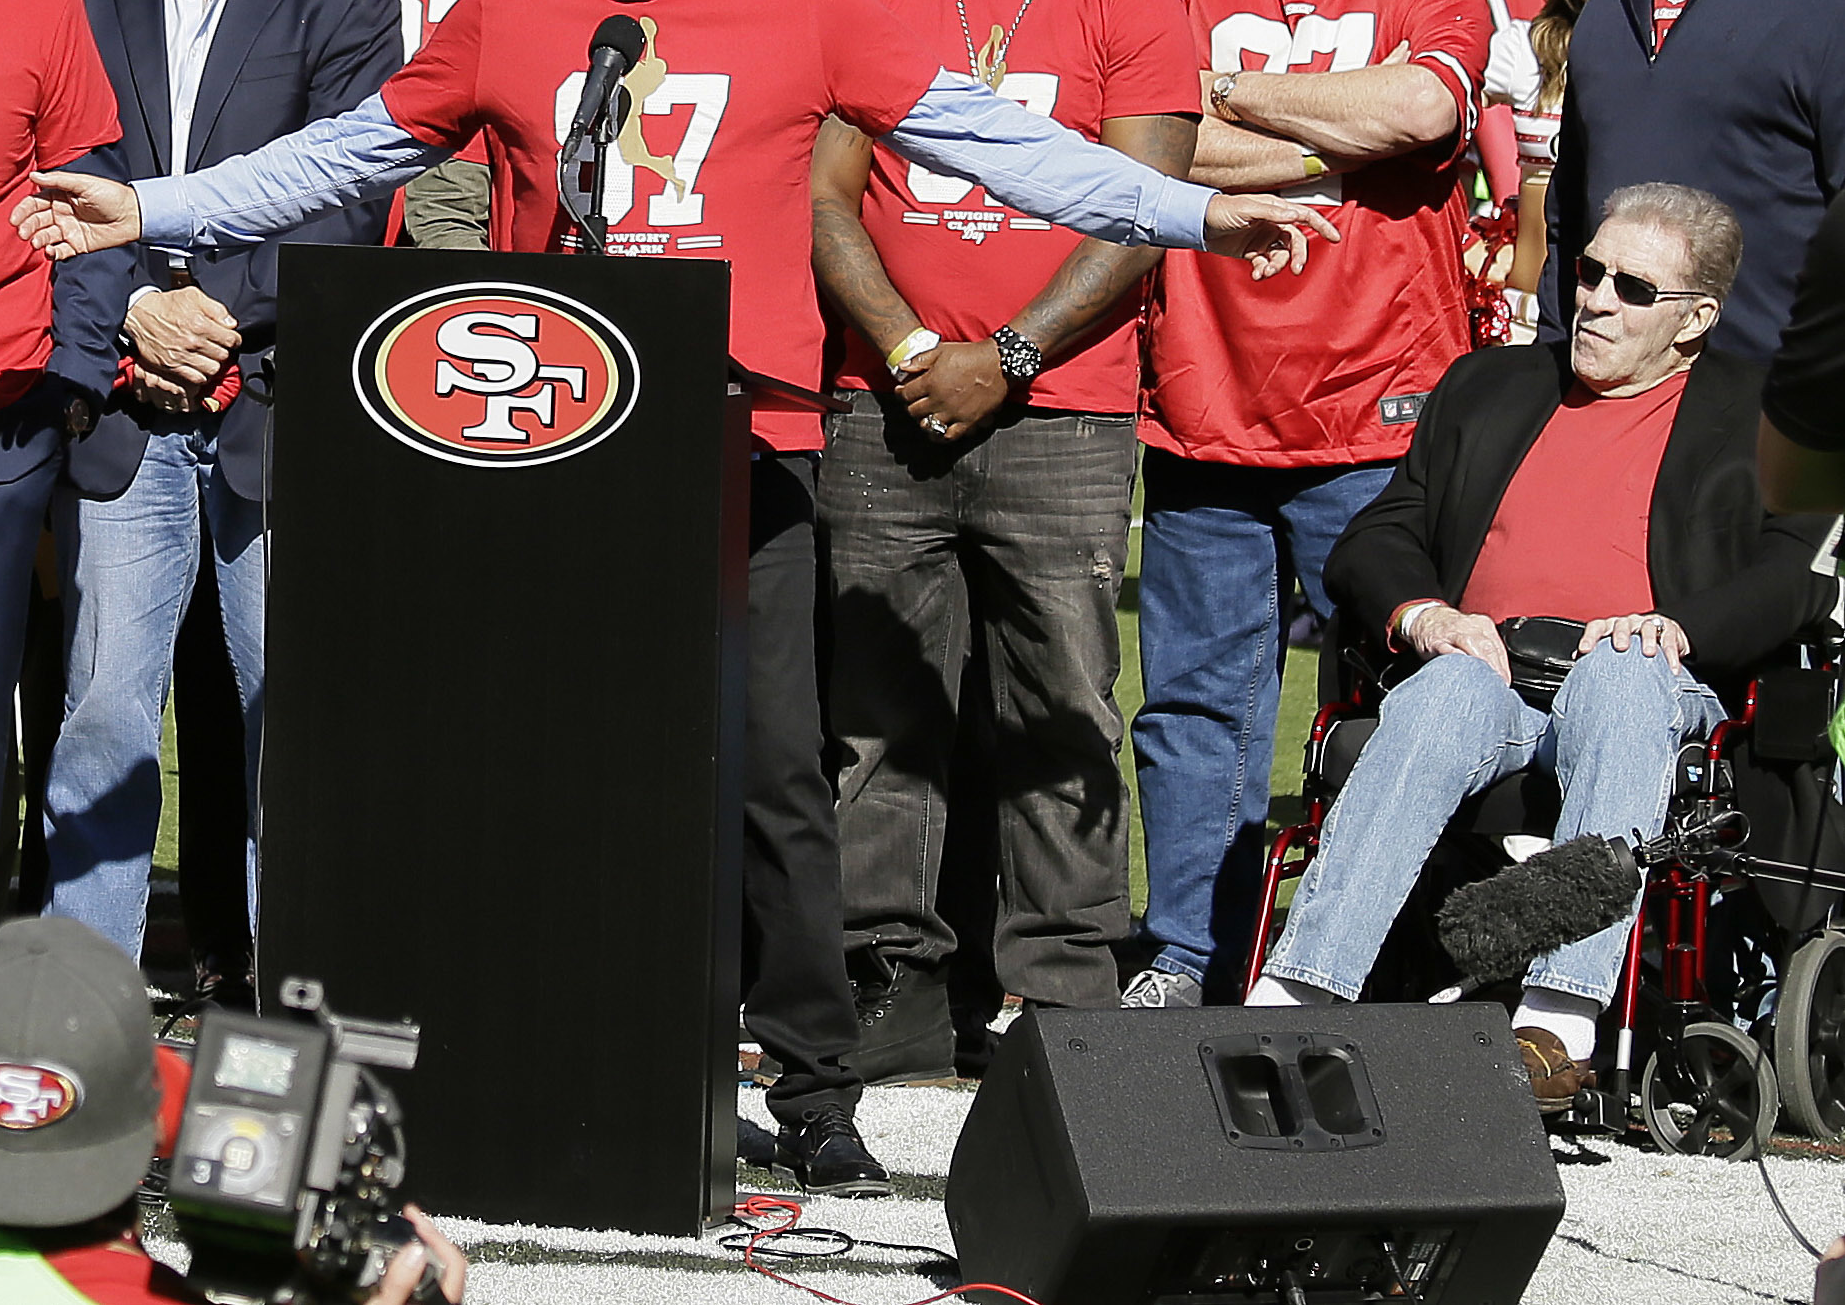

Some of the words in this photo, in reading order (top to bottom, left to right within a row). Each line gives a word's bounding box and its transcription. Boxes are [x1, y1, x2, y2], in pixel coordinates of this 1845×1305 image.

[943, 210, 1005, 222] DWIGHT
[946, 222, 1000, 232] CLARK
[607, 244, 665, 255] CLARK
[434, 311, 585, 443] SF
